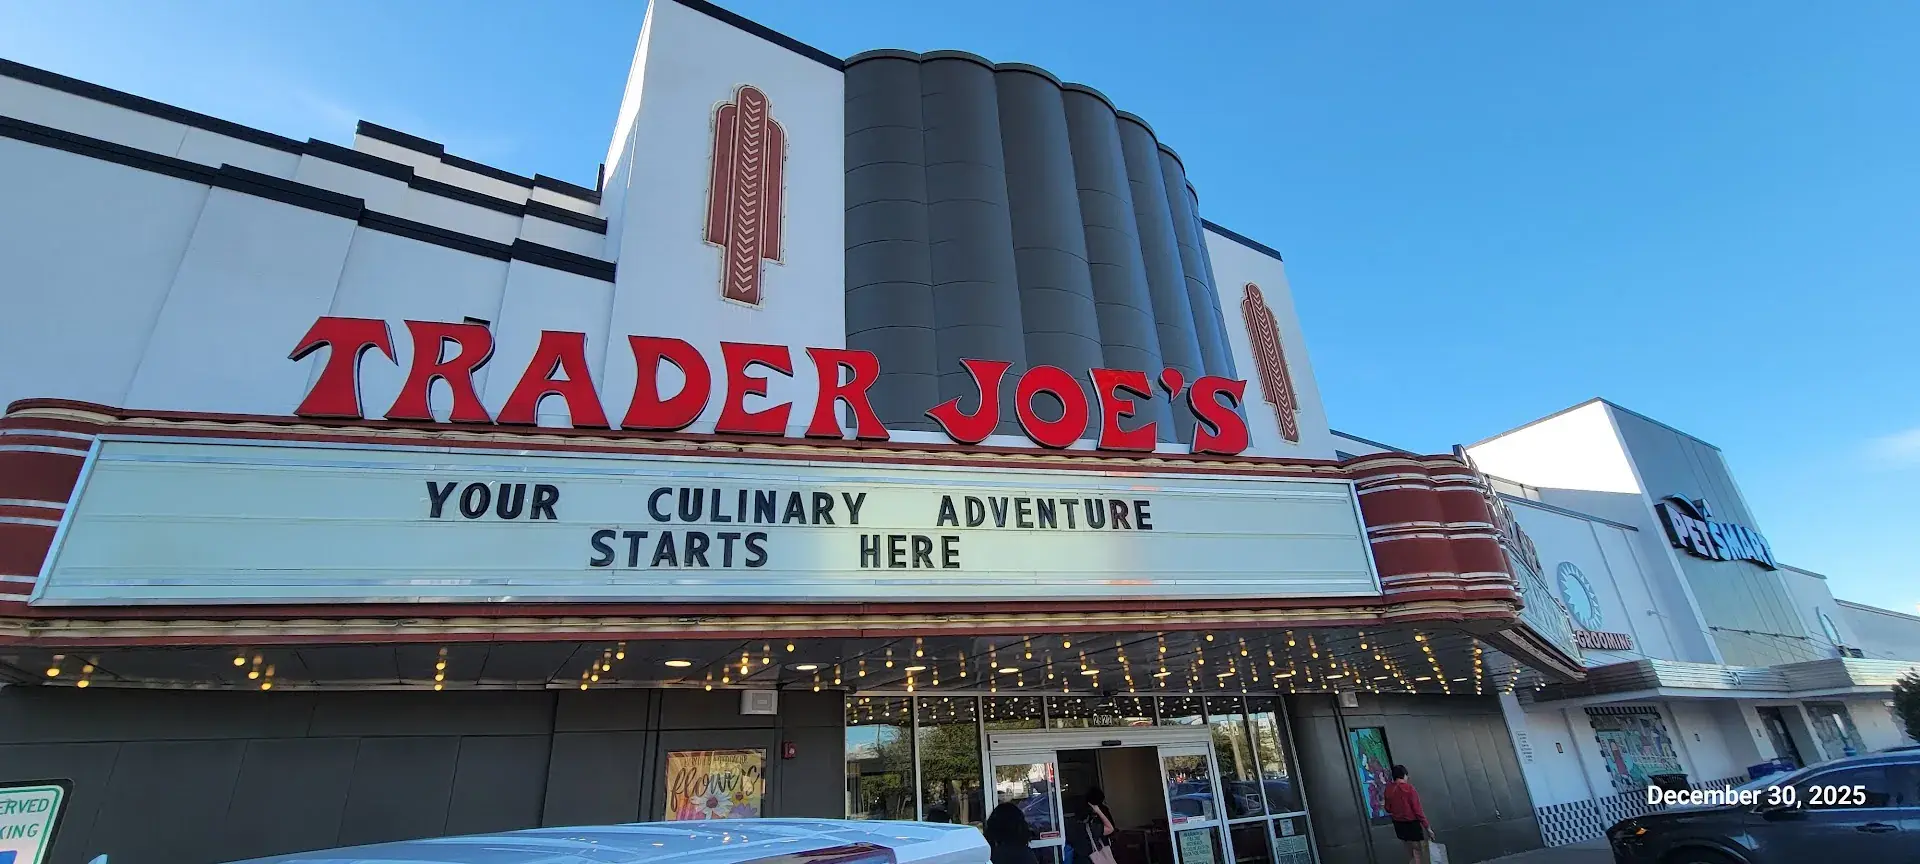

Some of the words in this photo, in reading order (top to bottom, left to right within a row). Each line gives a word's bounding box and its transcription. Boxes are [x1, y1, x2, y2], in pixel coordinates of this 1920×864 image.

[288, 316, 890, 441] TRADER
[925, 358, 1248, 455] JOE'S
[426, 481, 560, 520] YOUR
[648, 487, 866, 525] CULINARY
[937, 495, 1153, 530] ADVENTURE
[590, 530, 767, 568] STARTS
[860, 534, 961, 569] HERE
[1661, 503, 1777, 569] PETSMART
[1576, 631, 1634, 650] GROOMING
[671, 766, 760, 812] flowers
